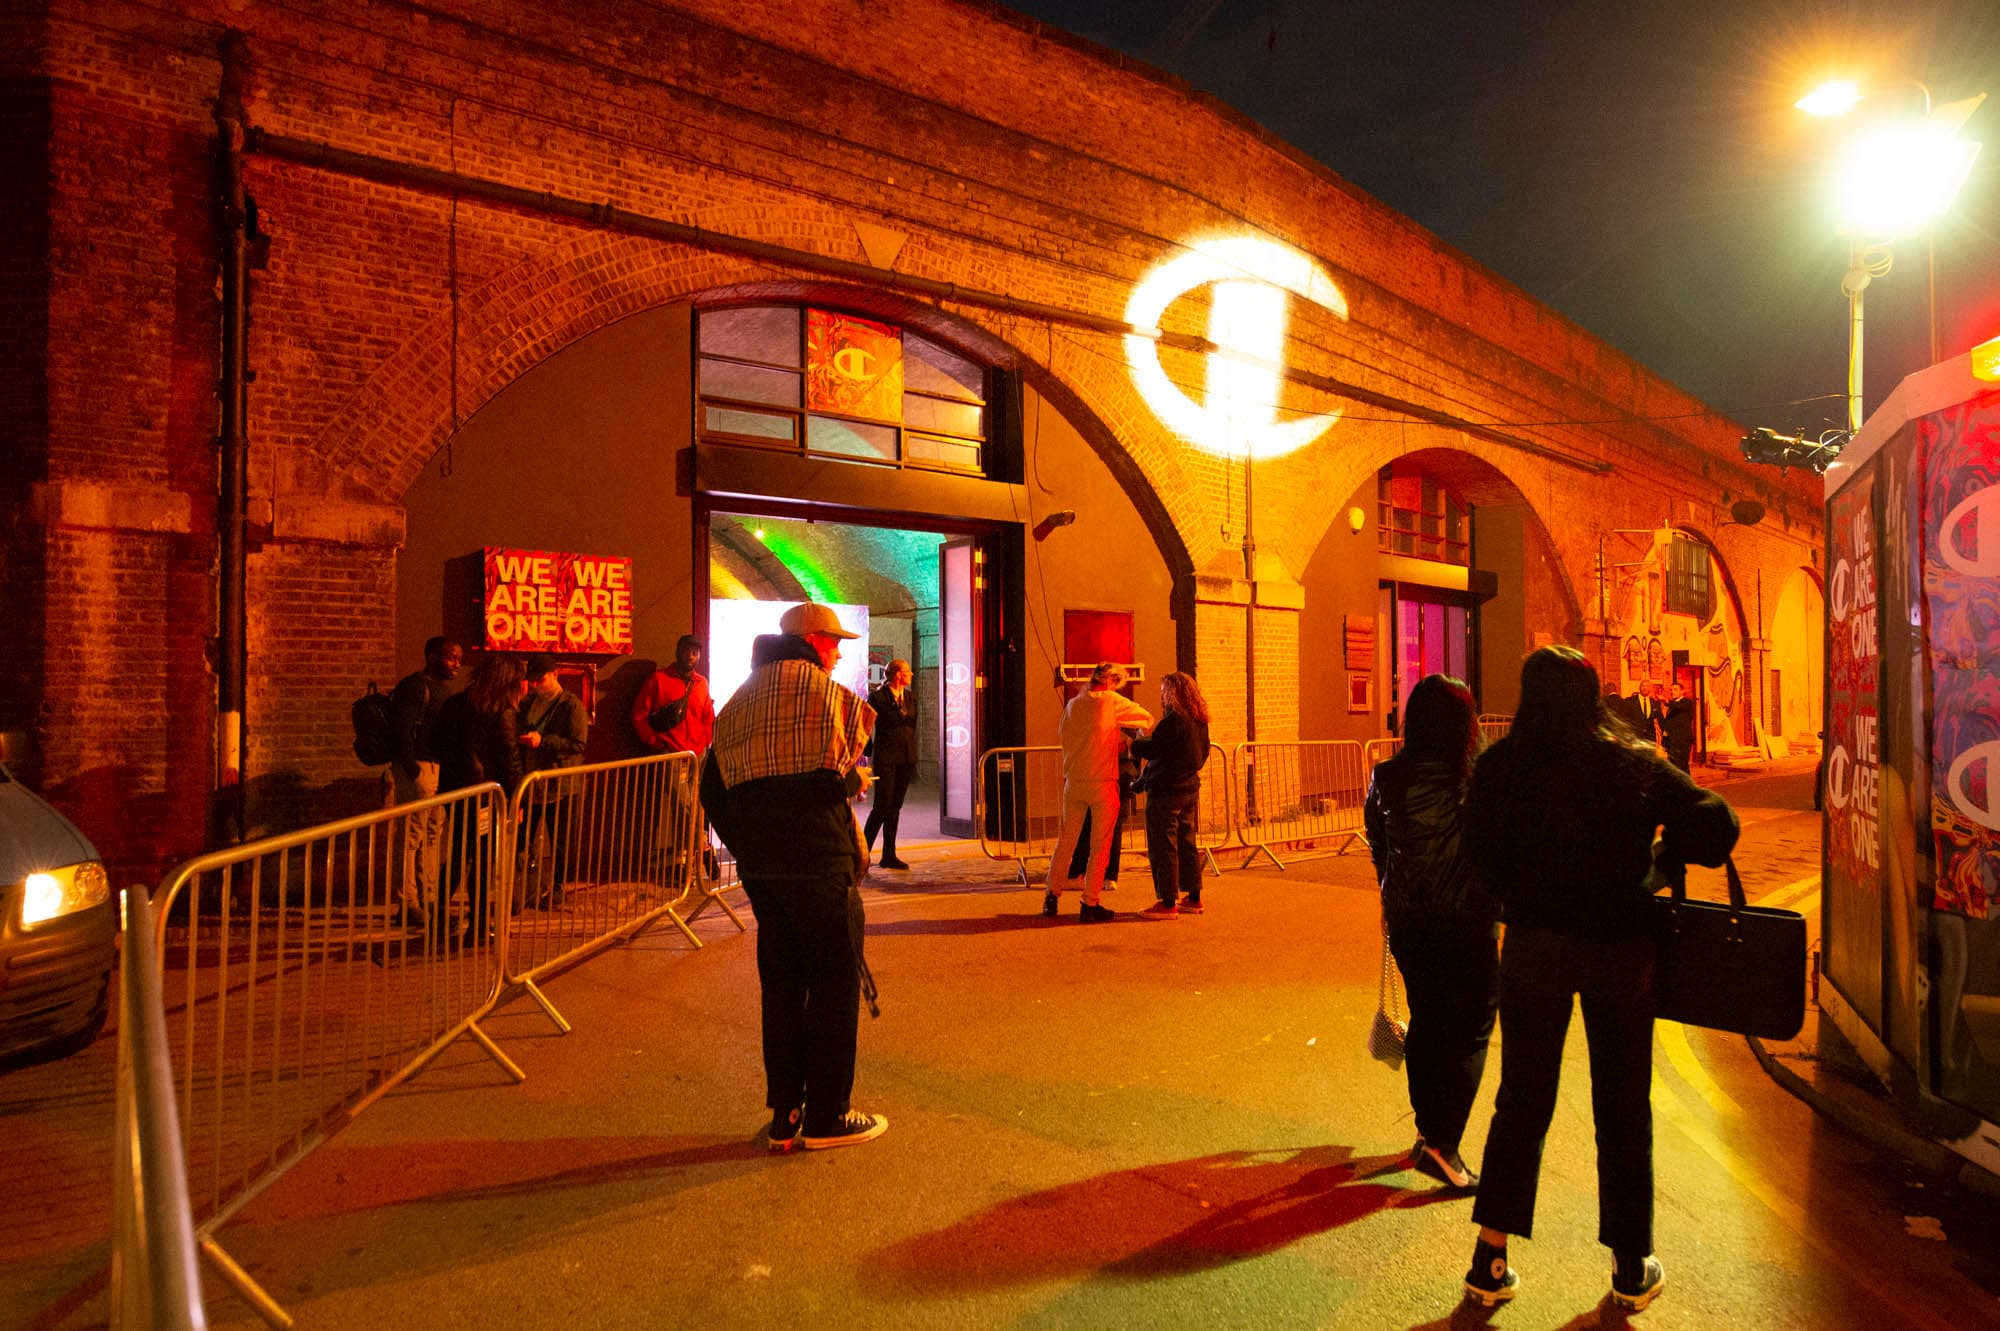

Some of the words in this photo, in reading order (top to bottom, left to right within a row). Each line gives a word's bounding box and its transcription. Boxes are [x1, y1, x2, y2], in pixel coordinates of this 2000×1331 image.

[1853, 506, 1871, 560] WE
[496, 555, 551, 585] WE
[573, 560, 625, 589] WE
[1853, 552, 1876, 611] ARE
[489, 584, 557, 613] ARE
[567, 588, 631, 616] ARE
[487, 612, 560, 642] ONE
[565, 616, 632, 643] ONE
[1852, 605, 1877, 659] ONE
[1855, 715, 1877, 764] WE
[1851, 764, 1878, 817] ARE
[1851, 814, 1879, 869] ONE
